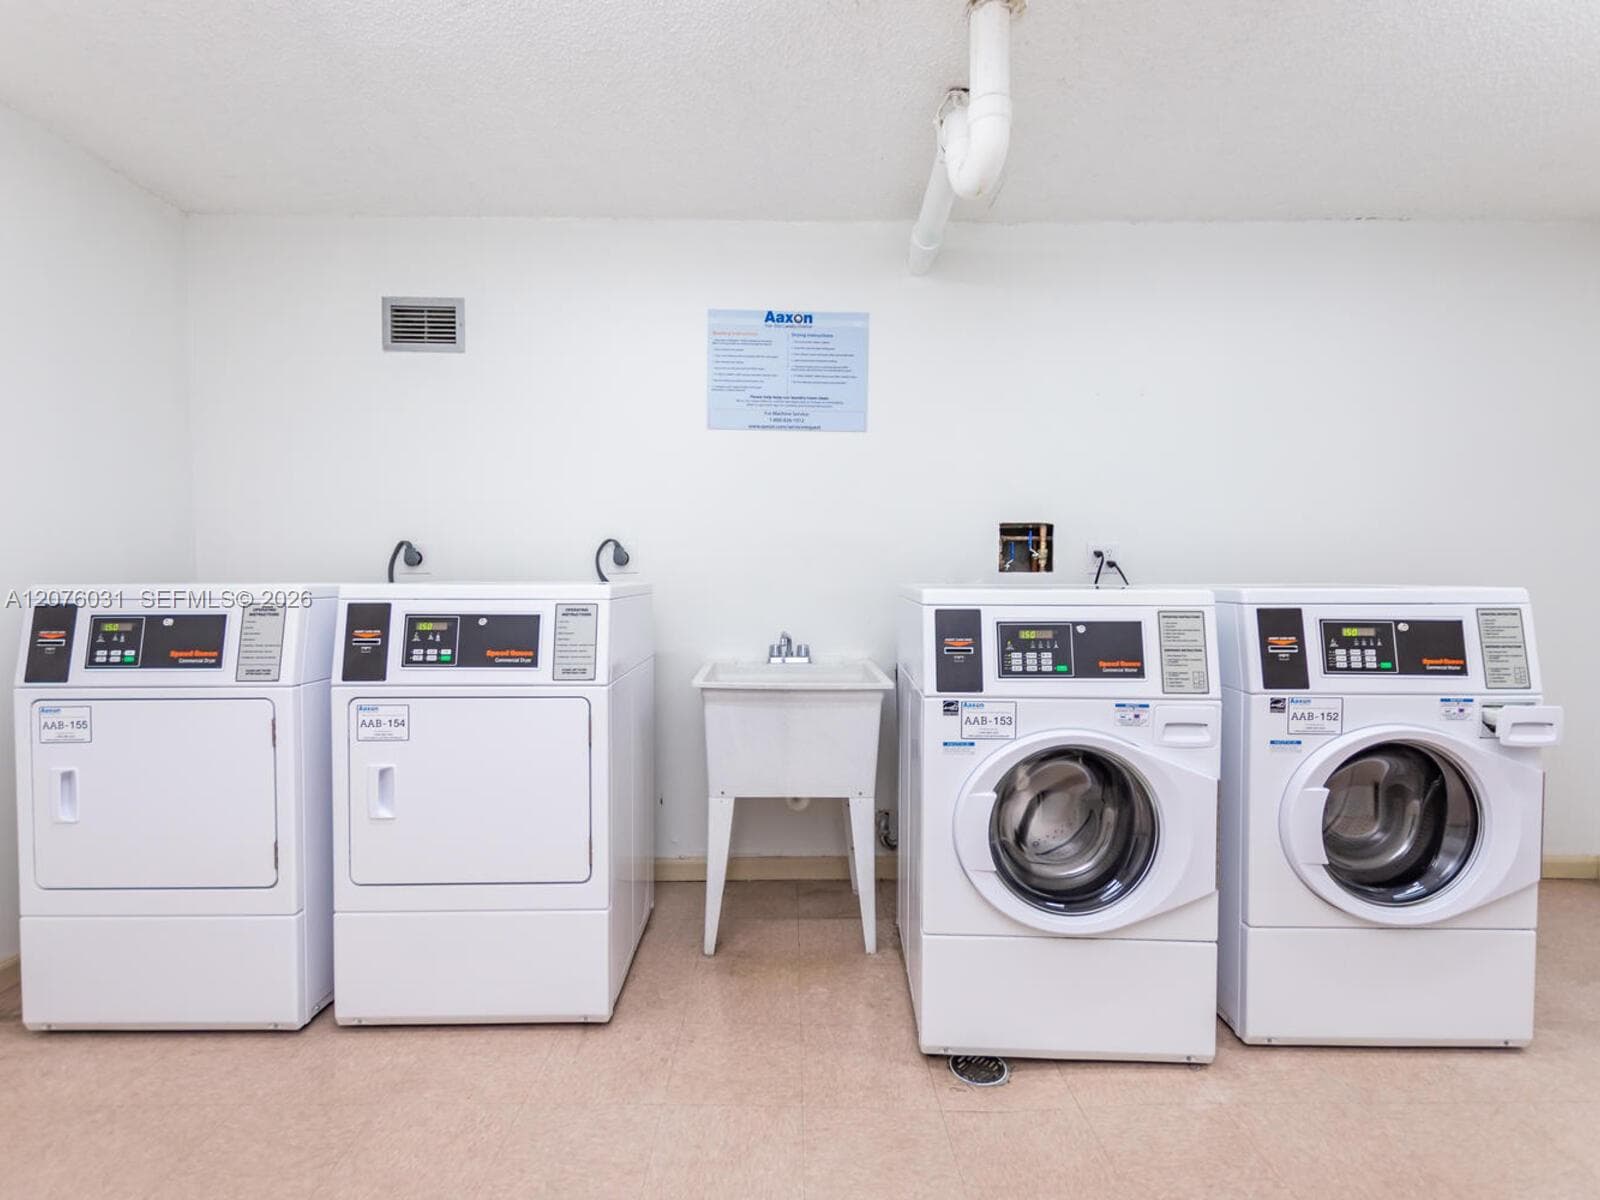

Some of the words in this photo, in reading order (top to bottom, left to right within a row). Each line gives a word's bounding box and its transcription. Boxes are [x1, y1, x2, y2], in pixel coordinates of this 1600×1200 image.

[764, 311, 813, 324] Aaxon
[964, 716, 1013, 726] AAB-153
[1291, 711, 1339, 721] AAB-152
[43, 720, 88, 730] AAB-155
[360, 718, 406, 728] AAB-154
